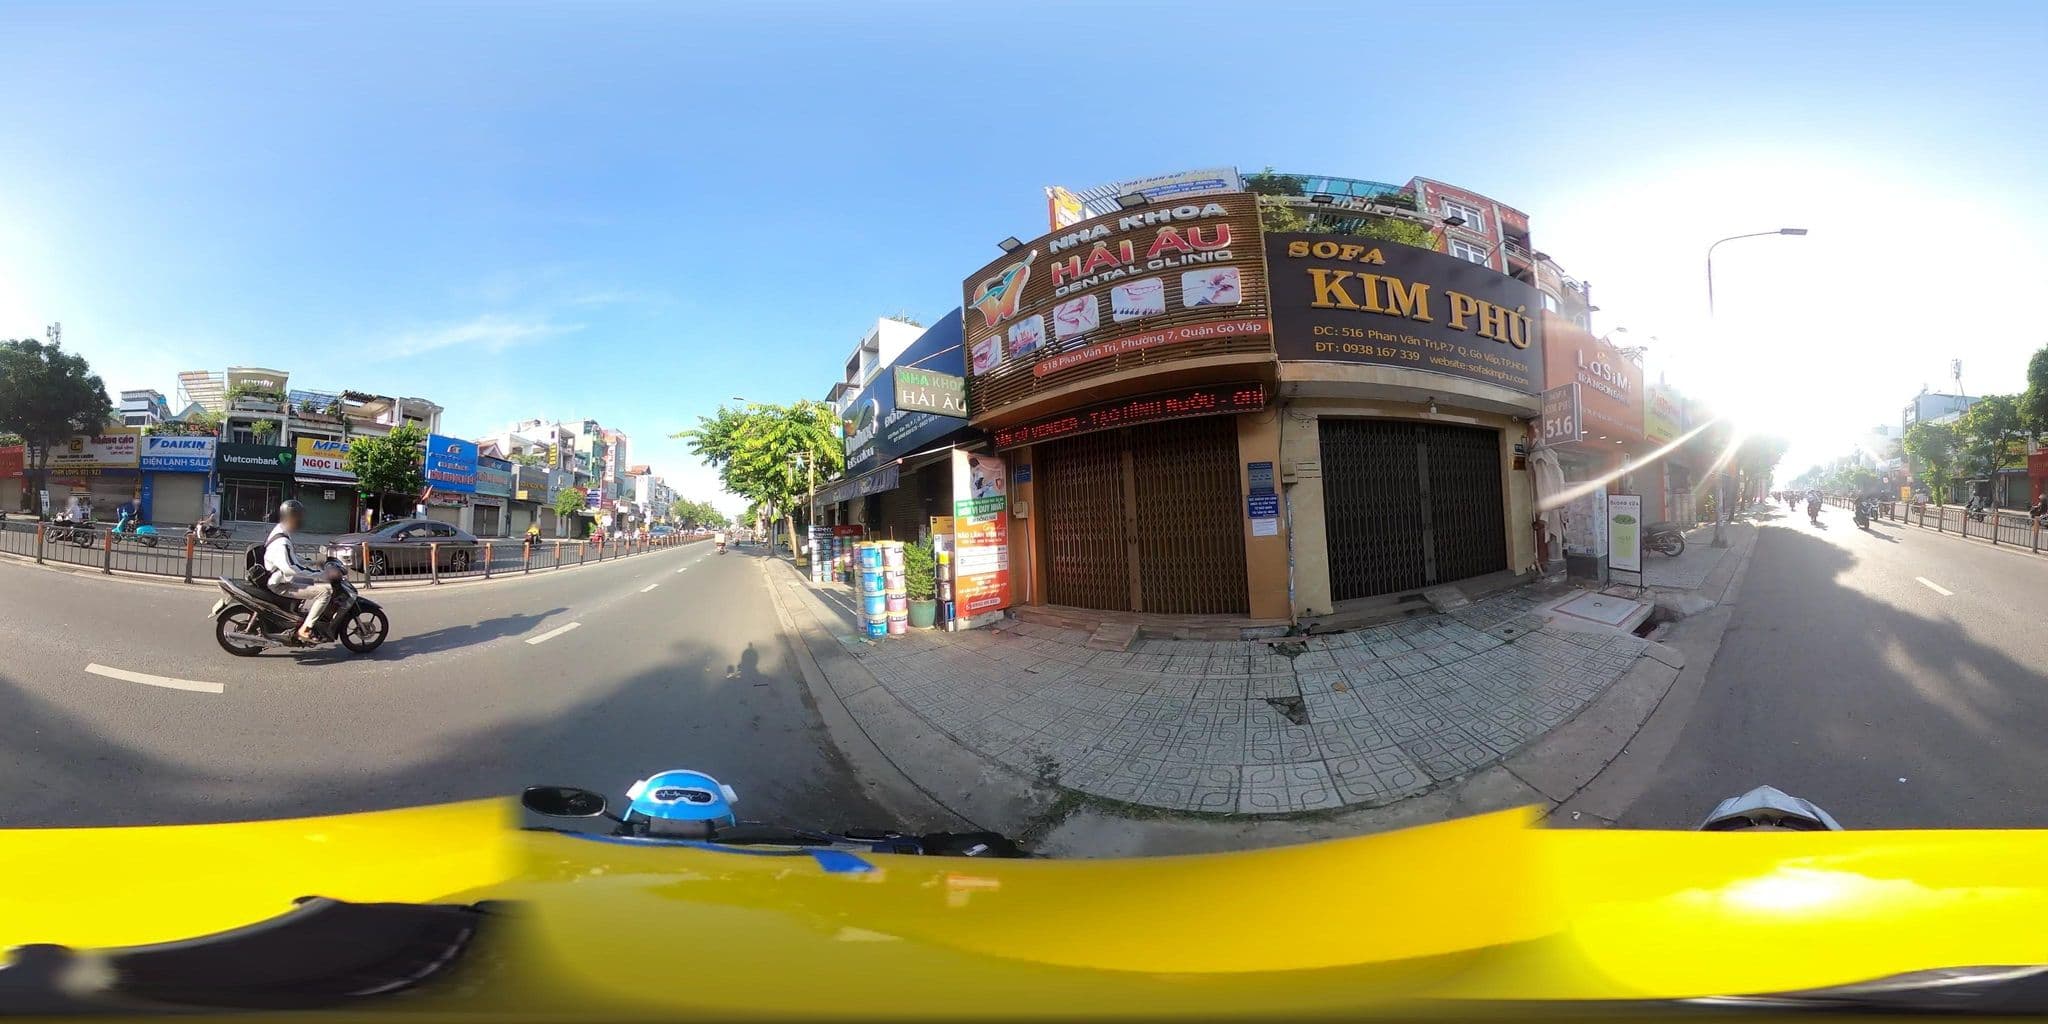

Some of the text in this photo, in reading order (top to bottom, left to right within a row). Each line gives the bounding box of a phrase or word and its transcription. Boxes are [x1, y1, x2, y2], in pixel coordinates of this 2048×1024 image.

[1050, 203, 1230, 254] NHA KHOA
[1050, 223, 1232, 287] HẢI ÂU
[1287, 240, 1387, 265] SOFA
[1055, 265, 1143, 298] DENTAL
[1307, 267, 1533, 350] KIM PHÚ
[1042, 360, 1058, 371] 518
[1058, 352, 1083, 369] Phan
[1083, 346, 1102, 360] Văn
[1121, 333, 1166, 350] Phường
[1167, 331, 1179, 343] 7,
[1181, 324, 1214, 339] Quận
[1217, 322, 1235, 334] Gò
[1236, 320, 1262, 333] Vấp
[1314, 326, 1339, 337] ĐC:
[1341, 328, 1364, 339] 516
[1368, 329, 1397, 344] Phan
[1399, 333, 1422, 347] Văn
[1314, 341, 1339, 353] ĐT:
[1342, 342, 1374, 356] 0938
[1376, 346, 1397, 359] 167
[1399, 350, 1421, 362] 339
[901, 371, 929, 386] NHA
[902, 387, 967, 412] HẢI ÂU
[1545, 416, 1572, 439] 516
[160, 440, 206, 449] DAIKIN
[142, 457, 163, 466] ĐIỆN
[163, 458, 188, 468] LẠNH
[223, 454, 279, 466] Vietcombank
[302, 457, 331, 470] NGỌC
